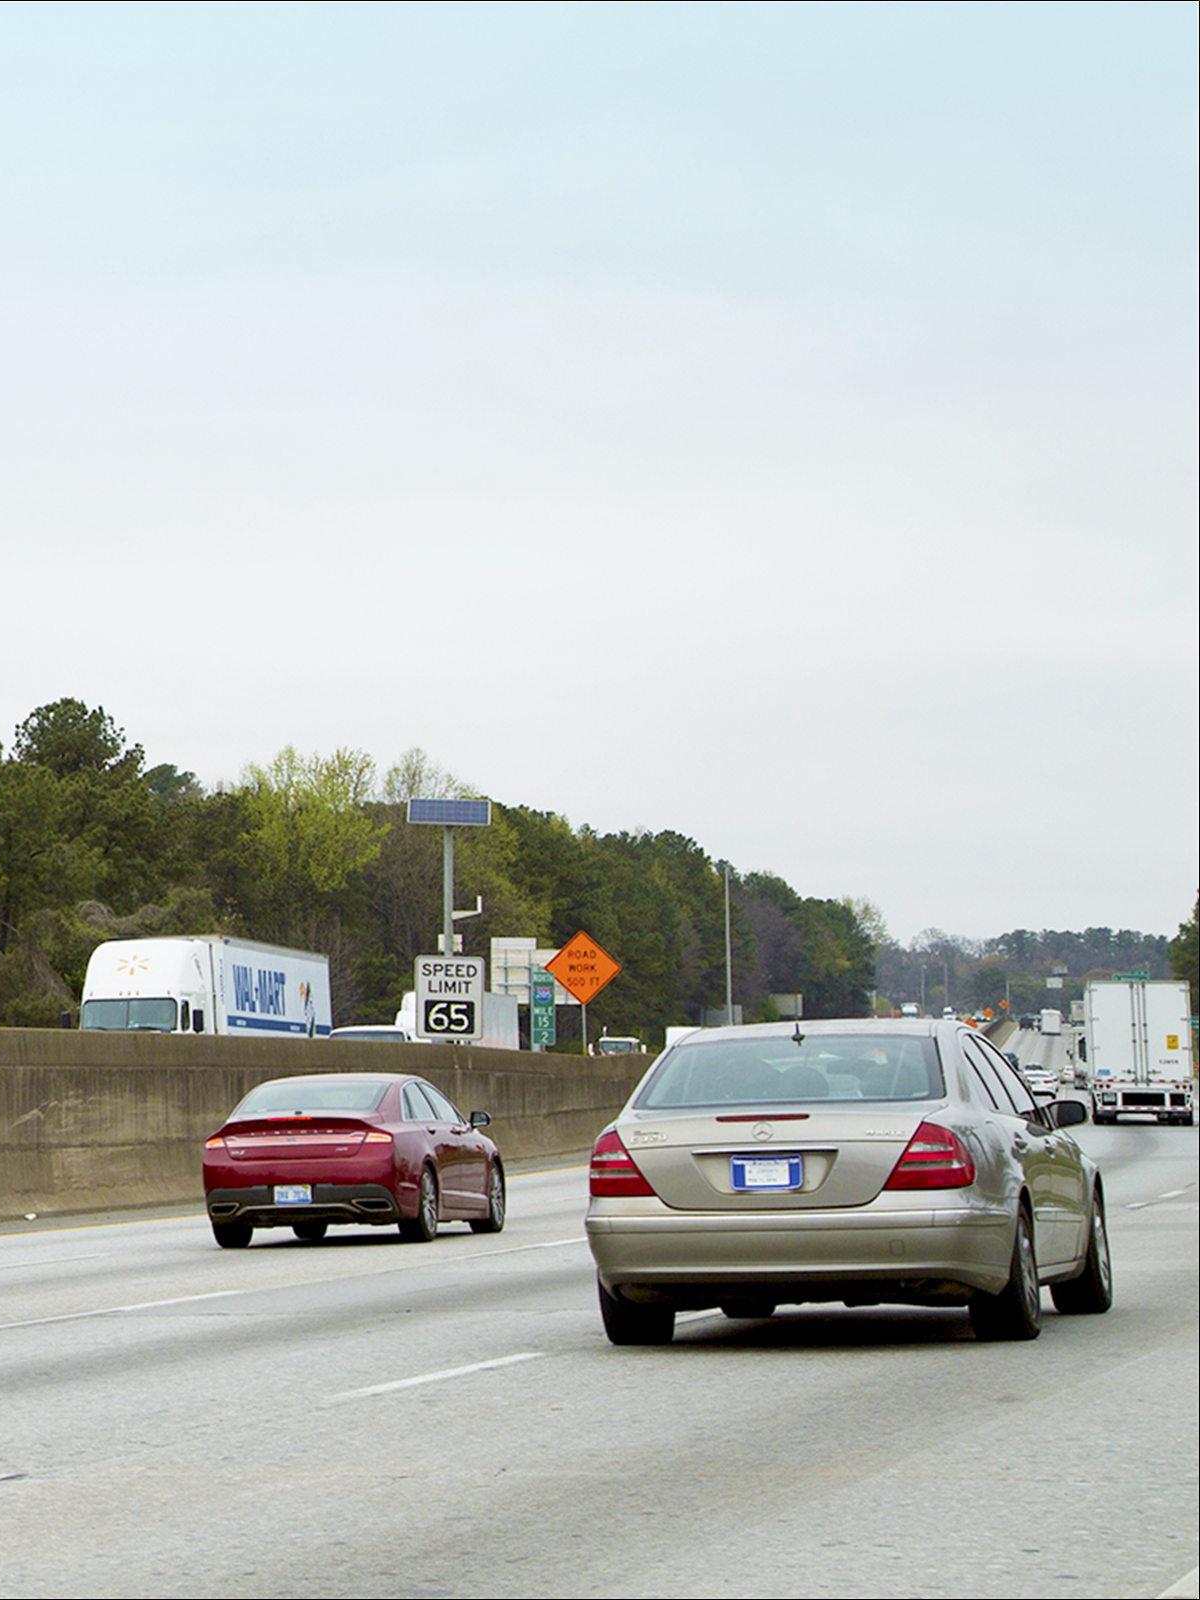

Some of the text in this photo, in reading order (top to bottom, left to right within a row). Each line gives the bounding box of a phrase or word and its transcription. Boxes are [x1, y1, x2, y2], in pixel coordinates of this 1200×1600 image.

[567, 949, 597, 959] ROAD
[421, 963, 478, 978] SPEED
[568, 963, 597, 973] WORK
[533, 973, 555, 982] NORTH
[567, 977, 600, 987] 500 FT
[428, 980, 473, 994] LIMIT
[534, 1006, 554, 1016] MILE
[428, 1002, 470, 1032] 65
[538, 1016, 550, 1028] 15
[541, 1031, 550, 1043] 2
